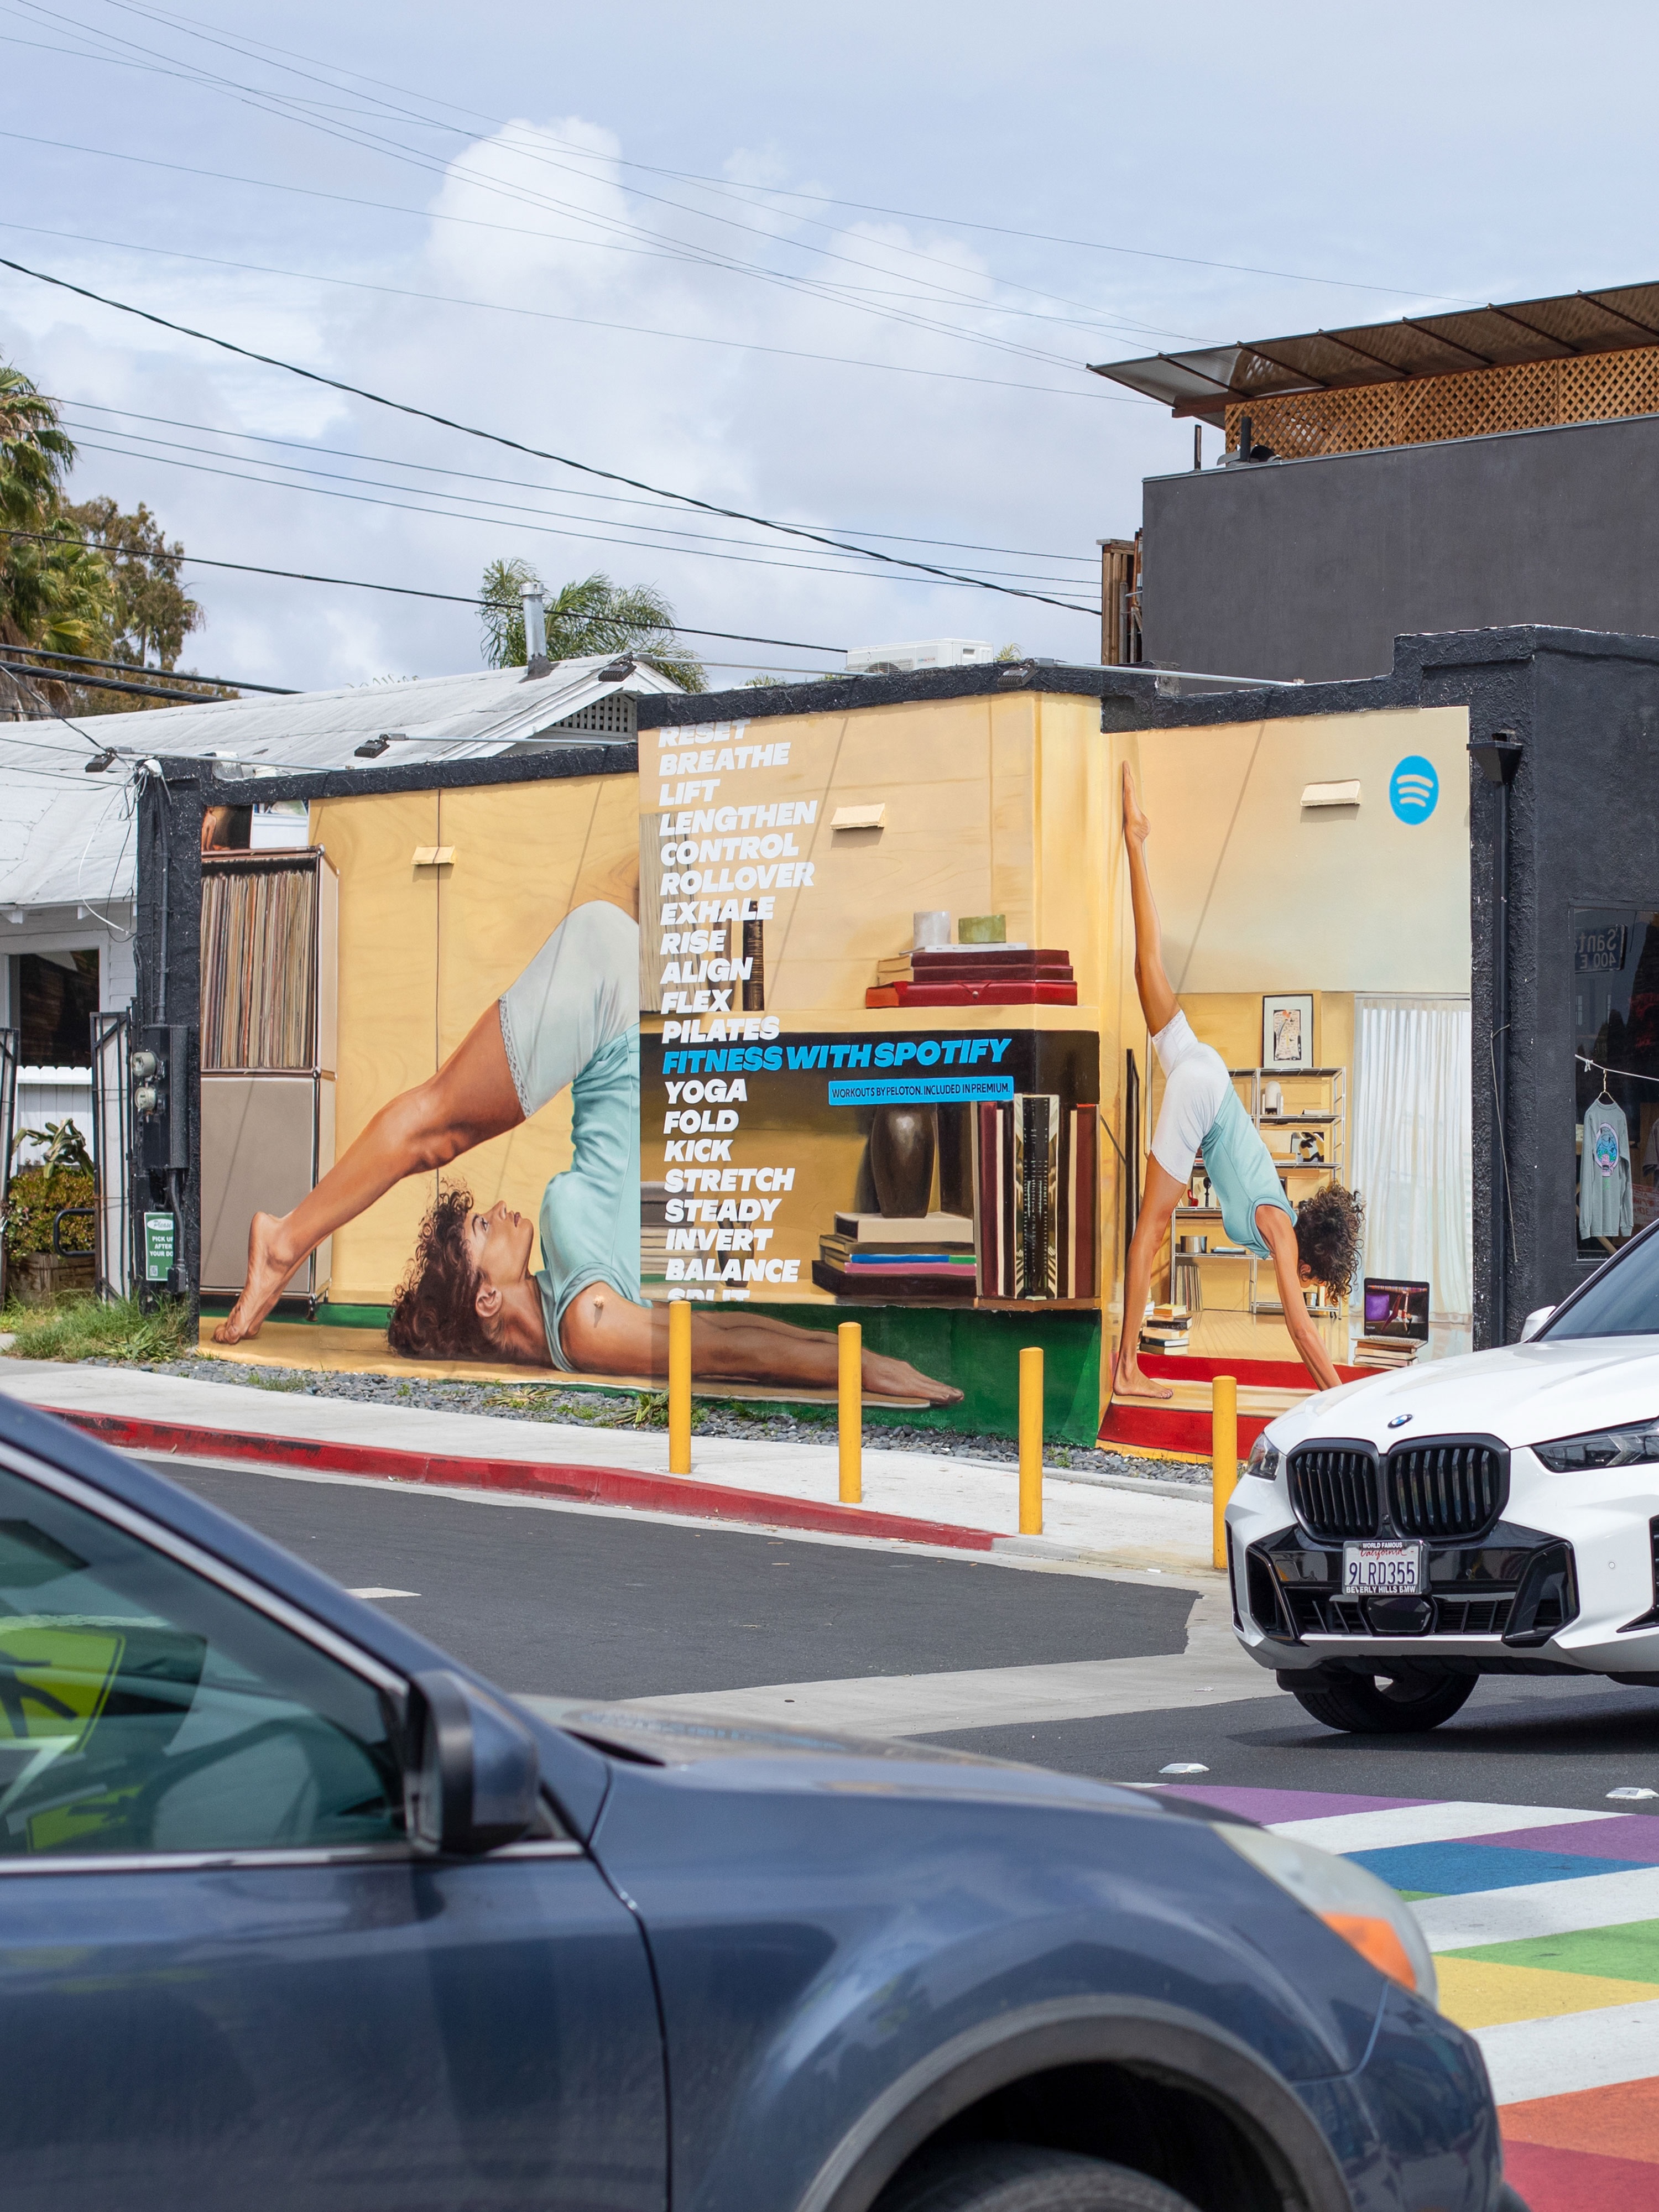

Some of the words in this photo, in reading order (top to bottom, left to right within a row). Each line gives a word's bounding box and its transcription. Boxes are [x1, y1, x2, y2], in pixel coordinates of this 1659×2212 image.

[659, 718, 751, 748] RESET
[659, 742, 791, 776] BREATHE
[659, 779, 721, 806] LIFT
[659, 800, 818, 836] LENGTHEN
[660, 832, 799, 866] CONTROL
[660, 862, 815, 896] ROLLOVER
[660, 896, 775, 925] EXHALE
[660, 930, 726, 955] RISE
[660, 957, 753, 984] ALIGN
[660, 989, 733, 1014] FLEX
[661, 1016, 780, 1044] PILATES
[662, 1046, 782, 1074] FITNESS
[786, 1044, 872, 1070] WITH
[874, 1039, 1012, 1067] SPOTIFY
[665, 1079, 747, 1104] YOGA
[832, 1087, 875, 1098] WORKOUTS
[877, 1087, 886, 1095] BY
[886, 1086, 923, 1095] PELOTON.
[924, 1084, 961, 1095] INCLUDED
[962, 1084, 971, 1093] IN
[972, 1083, 1010, 1093] PREMIUM.
[663, 1109, 739, 1134] FOLD
[664, 1139, 734, 1162] KICK
[664, 1167, 795, 1193] STRETCH
[664, 1198, 782, 1223] STEADY
[665, 1228, 774, 1251] INVERT
[665, 1258, 800, 1282] BALANCE
[1349, 1561, 1415, 1585] 9LRD355
